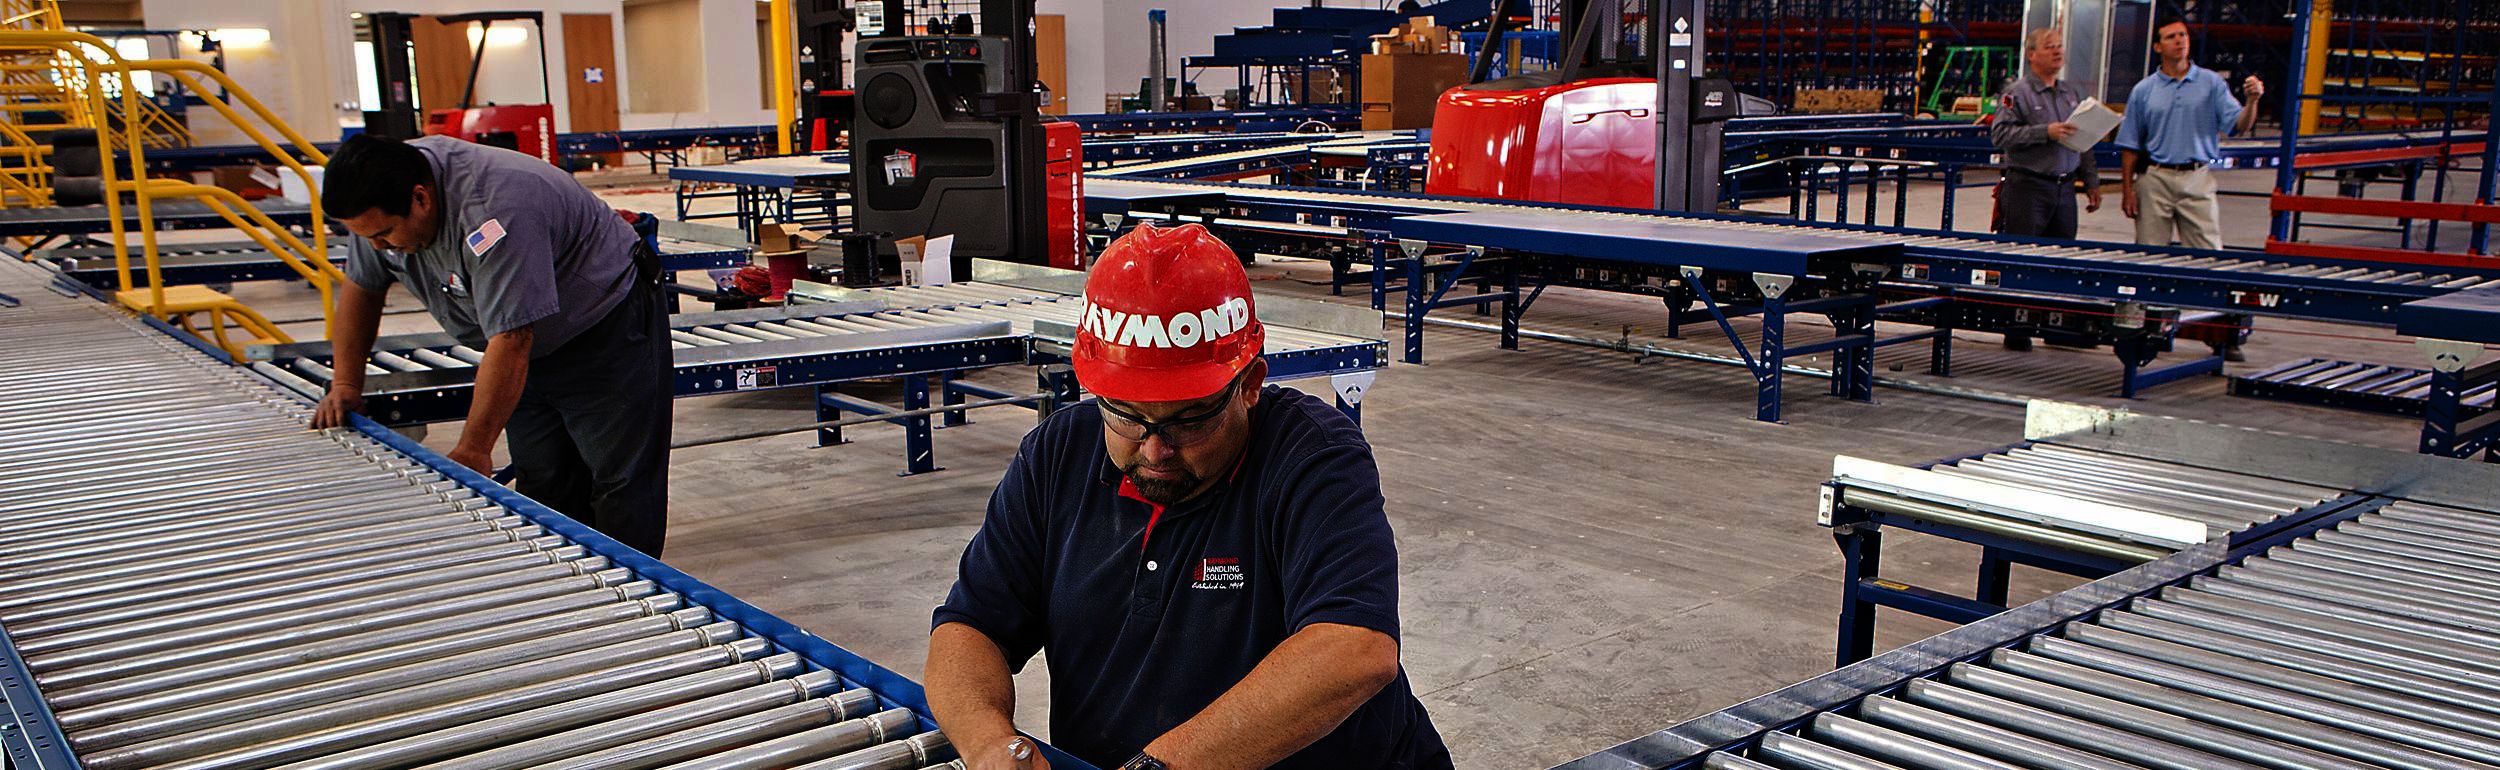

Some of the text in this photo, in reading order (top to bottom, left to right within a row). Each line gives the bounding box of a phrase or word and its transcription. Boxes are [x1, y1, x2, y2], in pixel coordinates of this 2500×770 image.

[539, 117, 550, 163] AYMOND
[2230, 290, 2280, 307] TGW
[1080, 289, 1248, 348] RAYMOND
[1205, 573, 1244, 581] SOLUTIONS
[1206, 565, 1240, 573] HANDLING
